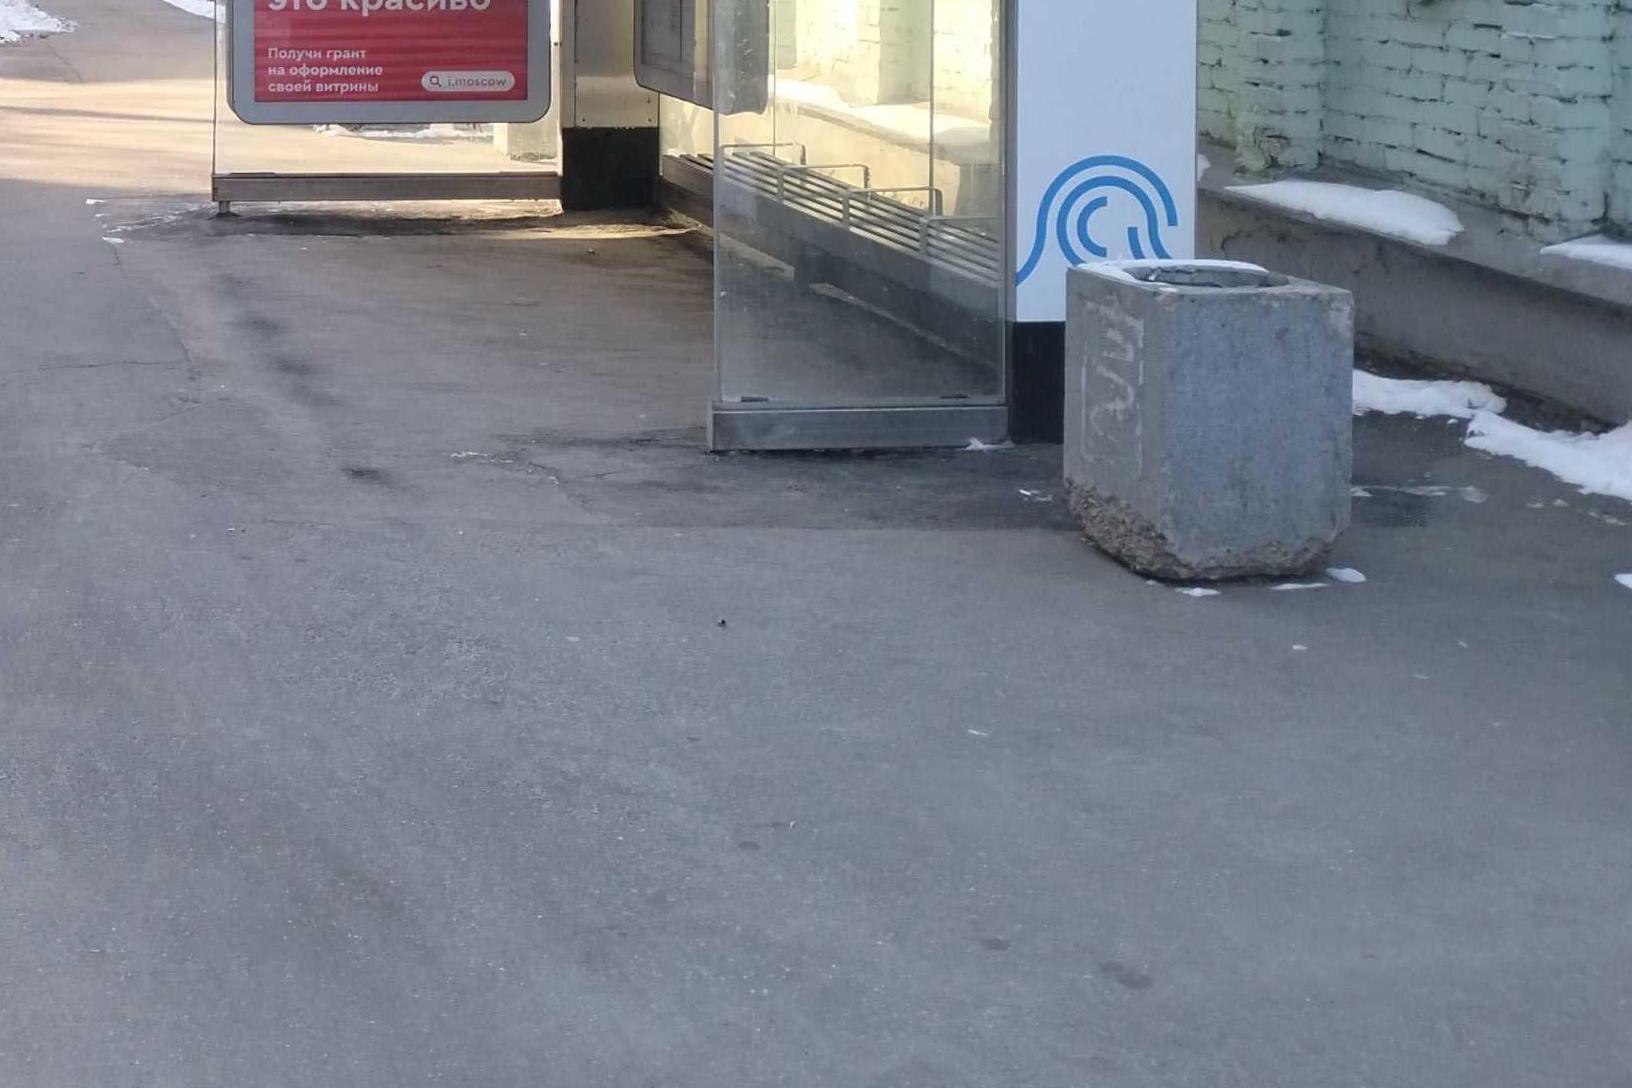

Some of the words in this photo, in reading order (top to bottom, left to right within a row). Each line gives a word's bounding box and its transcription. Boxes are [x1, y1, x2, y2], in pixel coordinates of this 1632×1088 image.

[268, 47, 322, 62] Получи
[326, 49, 367, 62] грант
[268, 66, 286, 76] на
[289, 62, 384, 78] оформление
[268, 79, 312, 92] своей
[316, 82, 379, 95] витрины
[447, 76, 507, 87] i.moscow
